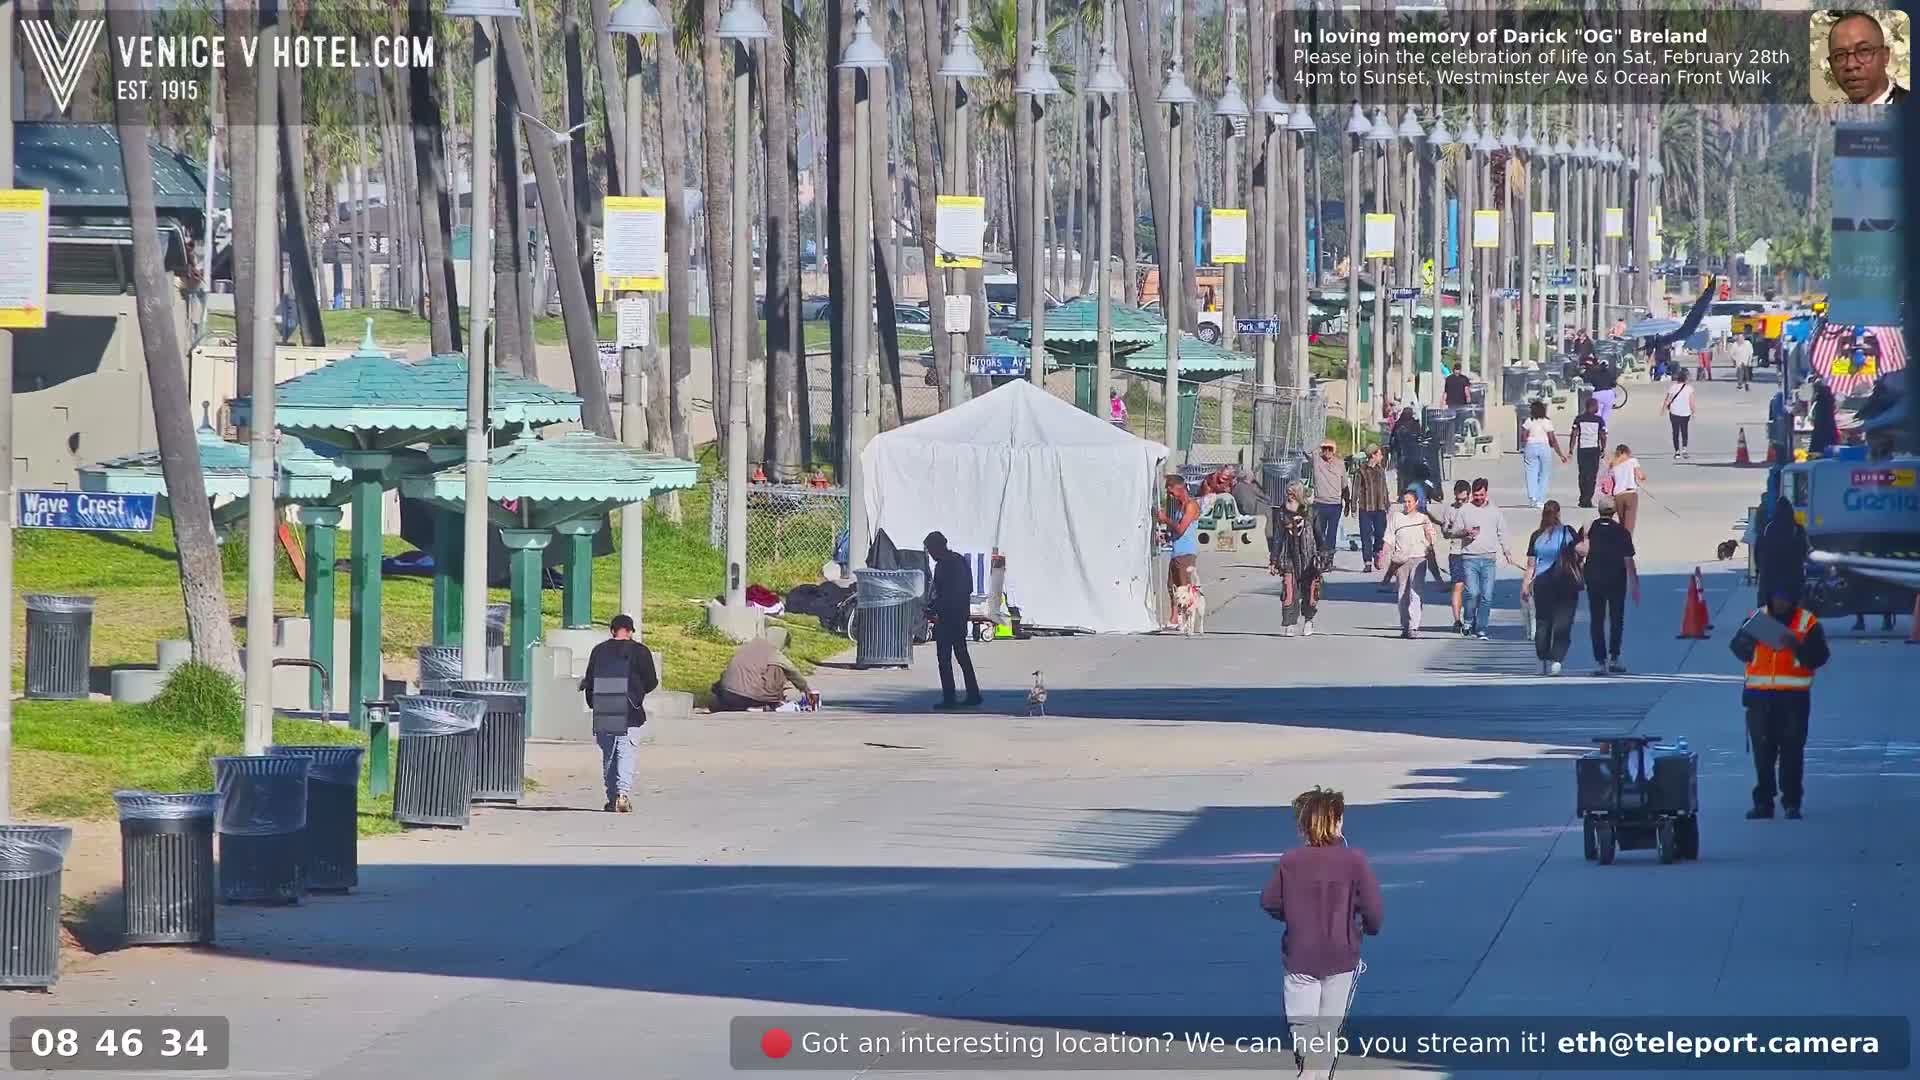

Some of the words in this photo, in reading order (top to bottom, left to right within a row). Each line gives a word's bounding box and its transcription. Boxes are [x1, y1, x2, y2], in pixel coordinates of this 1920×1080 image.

[1238, 322, 1254, 331] Park
[970, 356, 1002, 368] Brooks
[1012, 356, 1023, 367] Av
[24, 492, 69, 512] Wave
[77, 494, 127, 514] Crest
